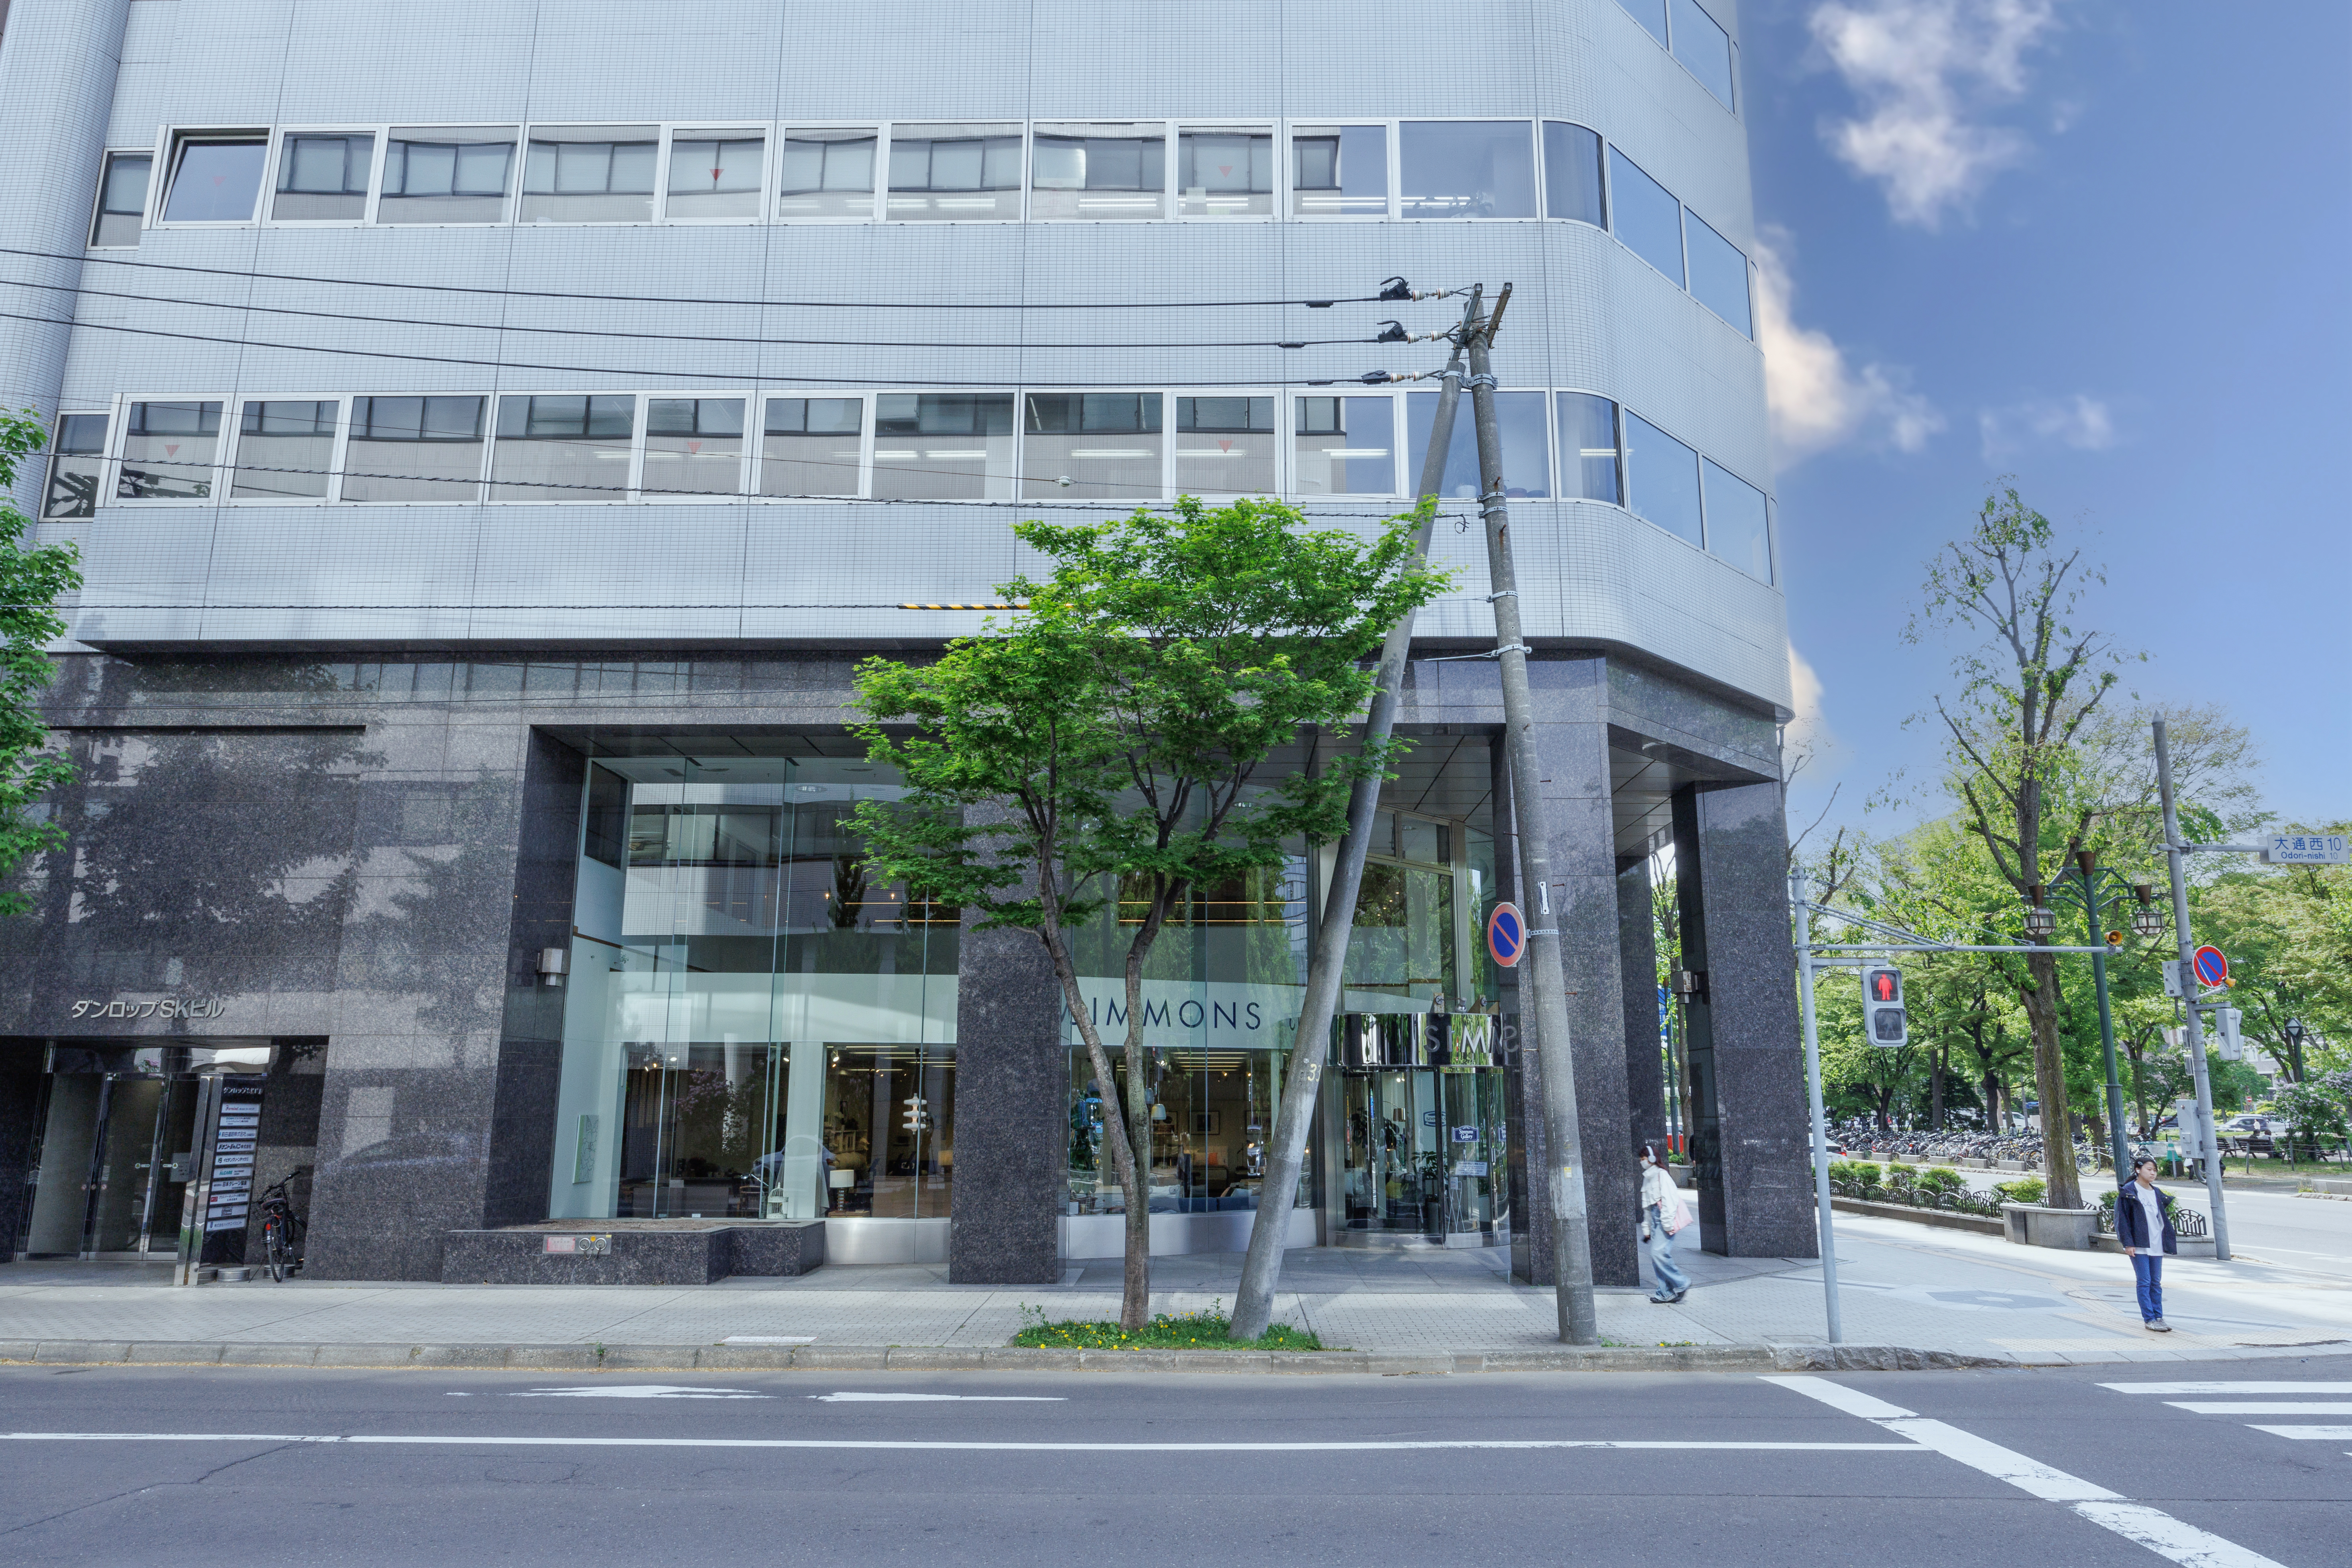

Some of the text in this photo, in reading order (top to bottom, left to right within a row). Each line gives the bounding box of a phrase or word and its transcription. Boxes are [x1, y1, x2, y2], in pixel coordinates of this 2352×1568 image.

[2274, 837, 2341, 851] 大通西10
[71, 1000, 225, 1018] ダンロップSKビル
[1071, 996, 1261, 1030] IMMONS
[1308, 1063, 1322, 1082] 33
